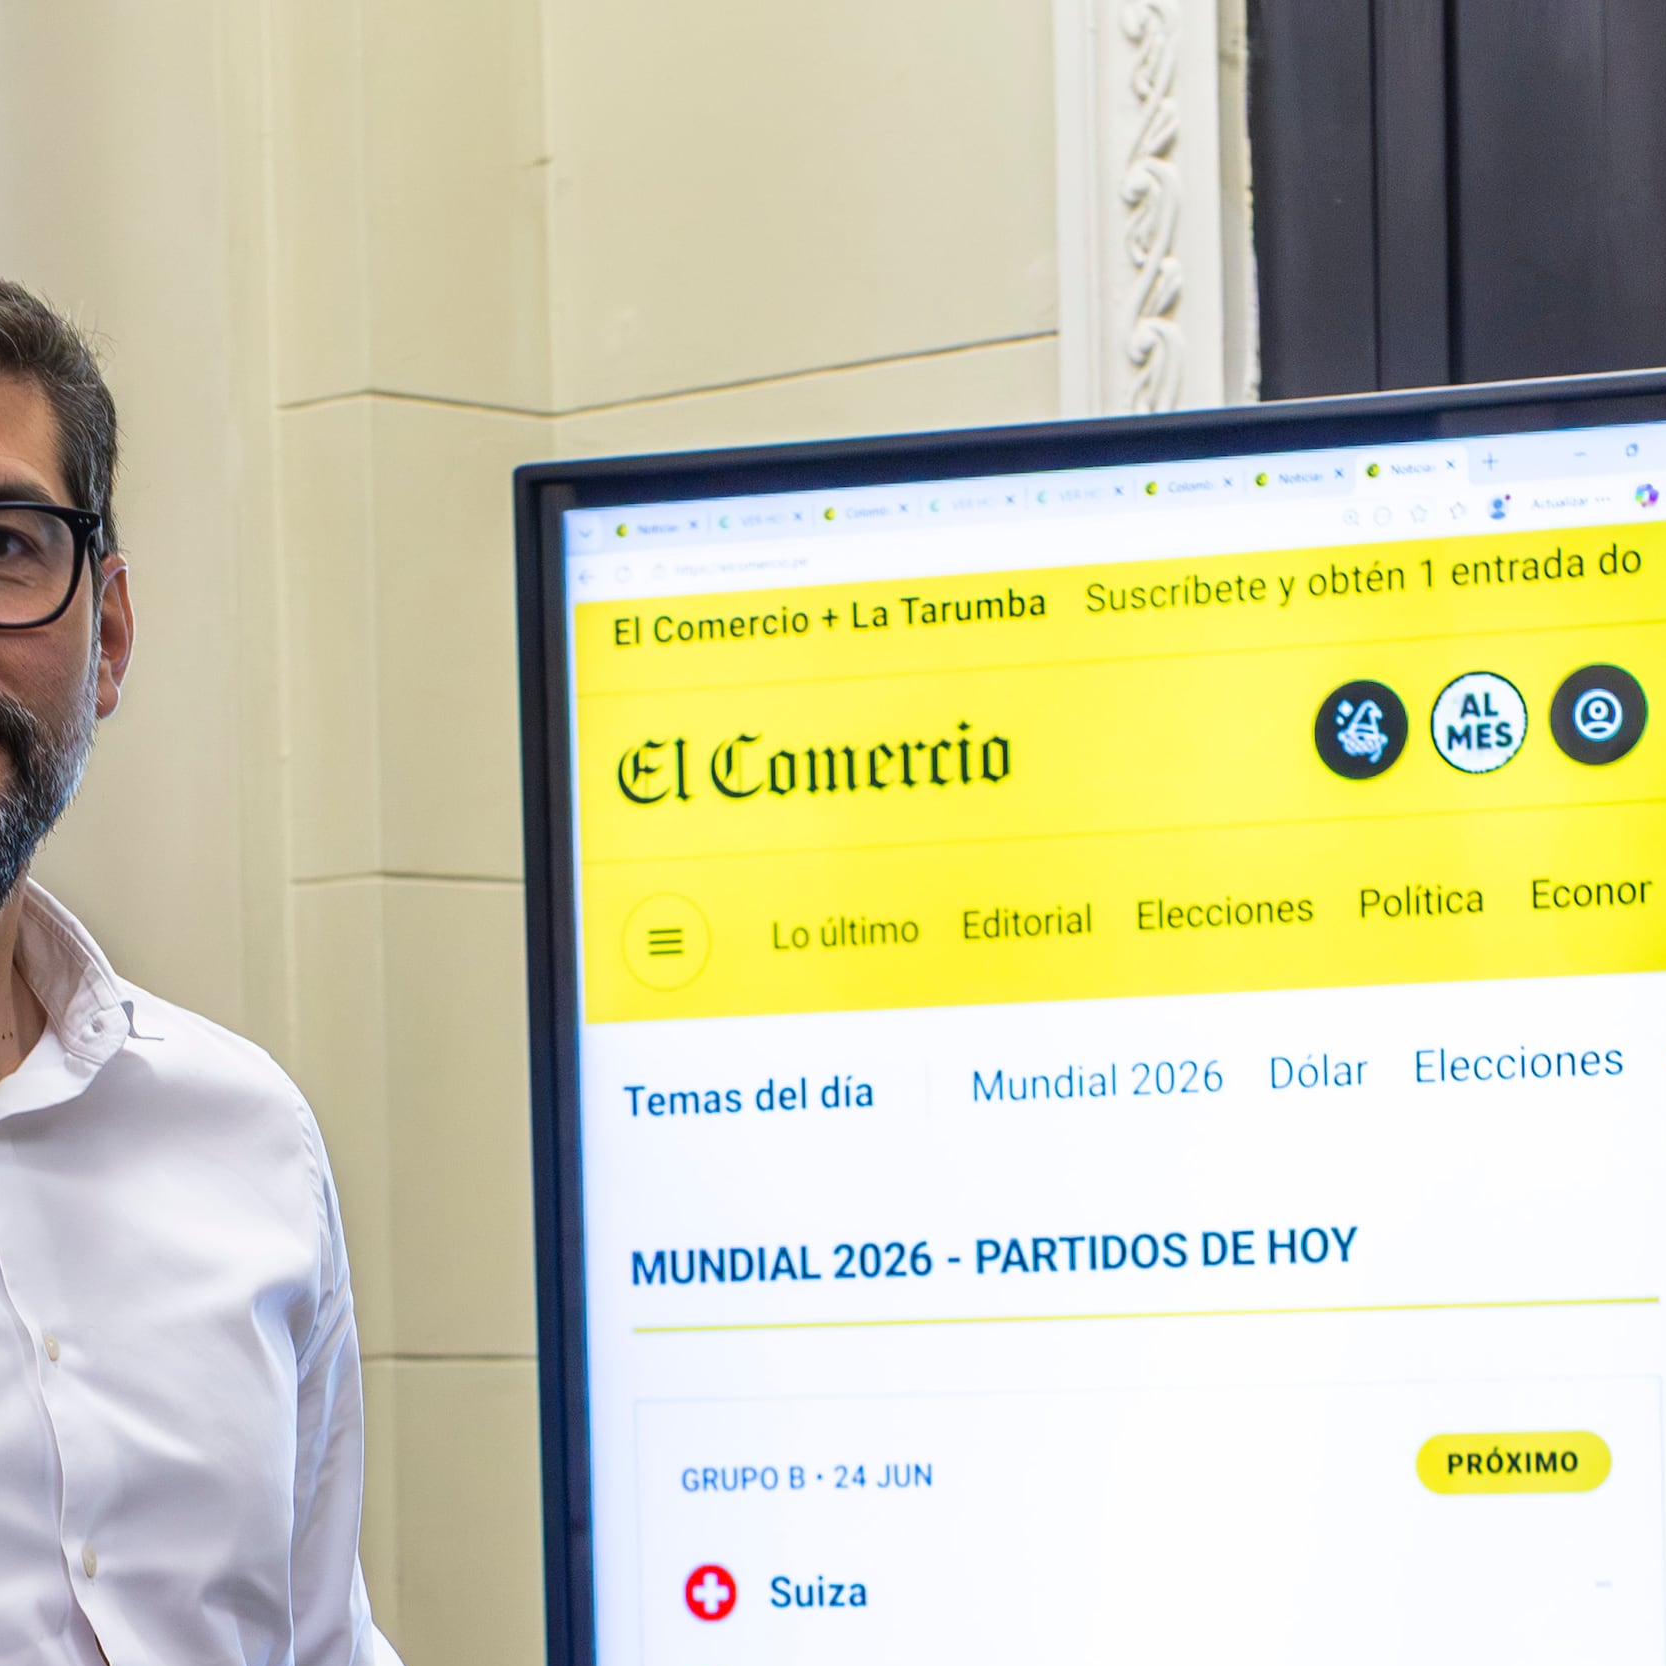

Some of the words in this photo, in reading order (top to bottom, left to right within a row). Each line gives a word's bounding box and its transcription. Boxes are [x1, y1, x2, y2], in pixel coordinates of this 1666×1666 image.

[1278, 470, 1324, 486] Noticia
[1390, 461, 1437, 476] Noticia
[1085, 573, 1268, 613] Suscríbete
[1278, 576, 1296, 606] y
[1307, 563, 1405, 597] obtén
[1419, 560, 1435, 589] 1
[1450, 548, 1585, 587] entrada
[1598, 544, 1643, 576] do
[614, 617, 642, 647] El
[652, 607, 810, 645] Comercio
[822, 608, 838, 629] +
[852, 601, 890, 630] La
[901, 589, 1048, 626] Tarumba
[1459, 691, 1500, 719] AL
[1445, 721, 1513, 751] MES
[617, 737, 694, 804] El
[710, 721, 1012, 799] Comercio
[1135, 897, 1315, 932] Elecciones
[1360, 882, 1485, 920] Política
[773, 920, 811, 951] Lo
[820, 916, 920, 948] último
[963, 903, 1093, 940] Editorial
[971, 1062, 1119, 1103] Mundial
[1131, 1059, 1225, 1097] 2026
[1270, 1051, 1369, 1090] Dólar
[1415, 1045, 1625, 1083] Elecciones
[623, 1084, 743, 1118] Temas
[755, 1077, 808, 1113] del
[820, 1074, 875, 1110] día
[631, 1246, 822, 1287] MUNDIAL
[832, 1240, 934, 1280] 2026
[975, 1232, 1188, 1276] PARTIDOS
[1201, 1230, 1256, 1267] DE
[1268, 1225, 1359, 1265] HOY
[681, 1466, 780, 1493] GRUPO
[789, 1466, 806, 1489] B
[833, 1465, 868, 1489] 24
[876, 1463, 935, 1489] JUN
[1447, 1445, 1579, 1476] PRÓXIMO
[770, 1574, 869, 1609] Suiza
